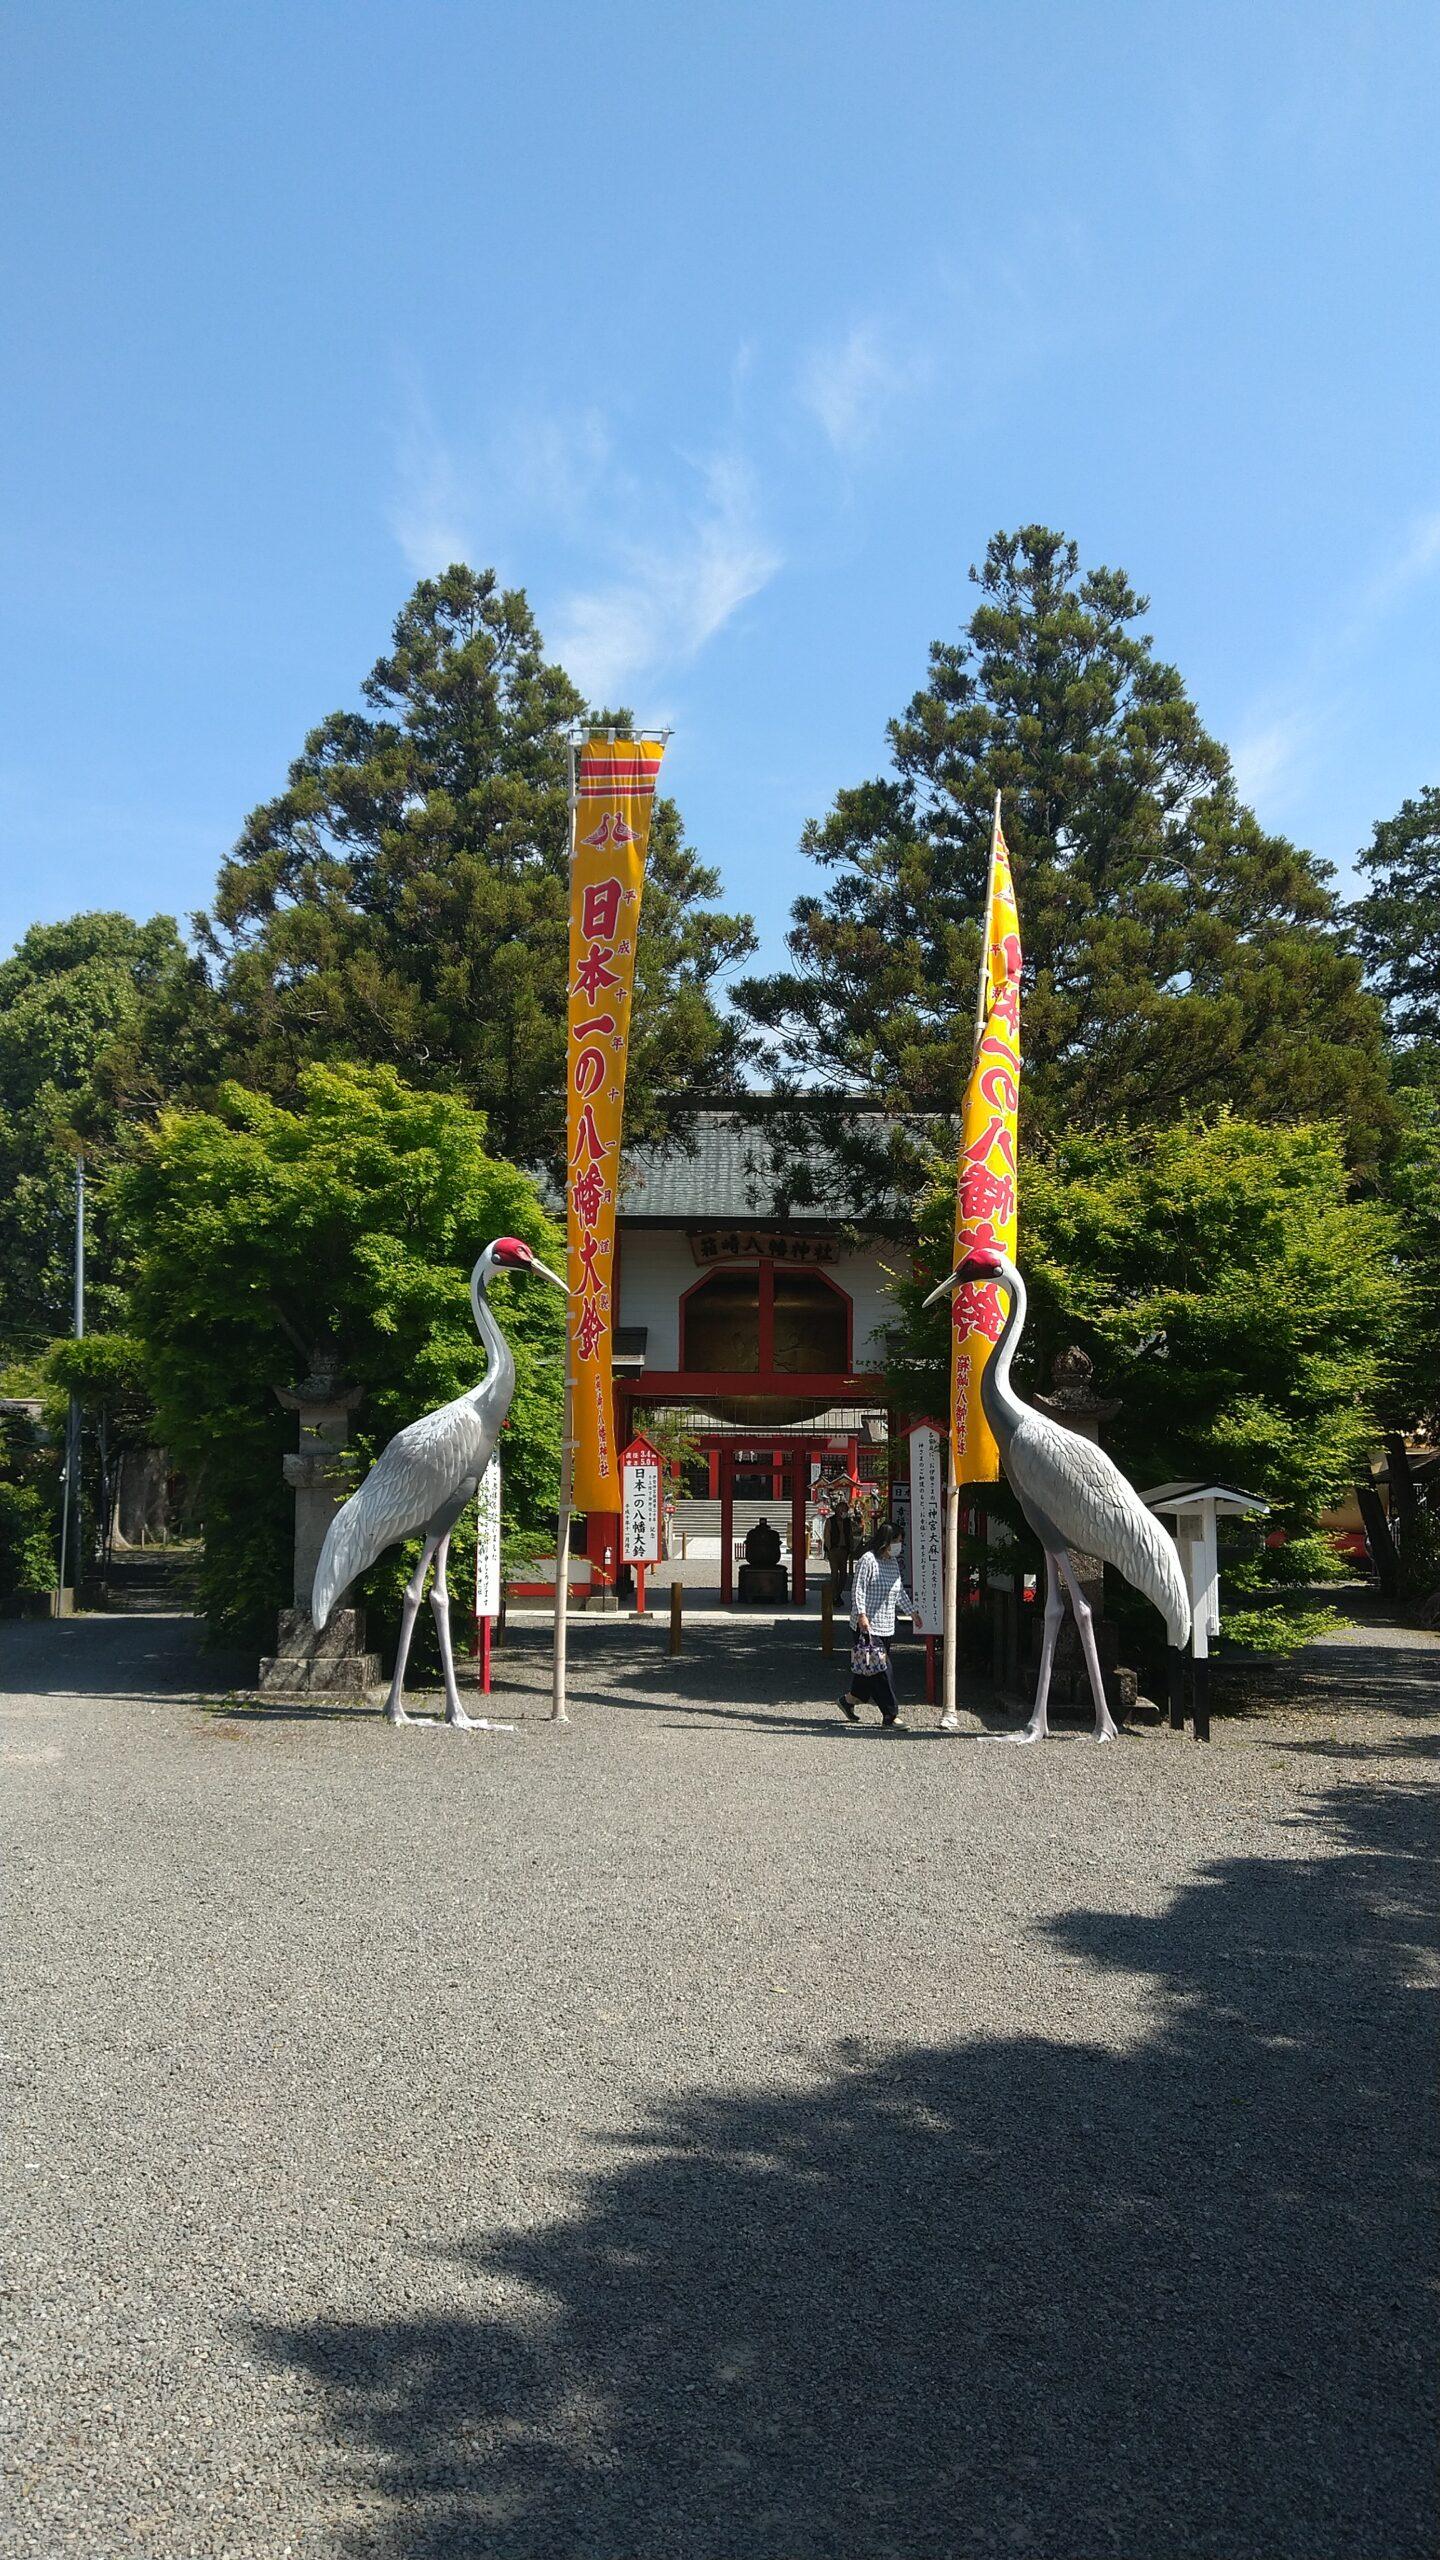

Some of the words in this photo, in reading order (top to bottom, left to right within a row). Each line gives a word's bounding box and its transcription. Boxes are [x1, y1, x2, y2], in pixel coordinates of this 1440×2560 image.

[571, 878, 623, 1362] 日本一の八幡大鈴
[632, 1468, 646, 1557] 日本一の八幡大鈴
